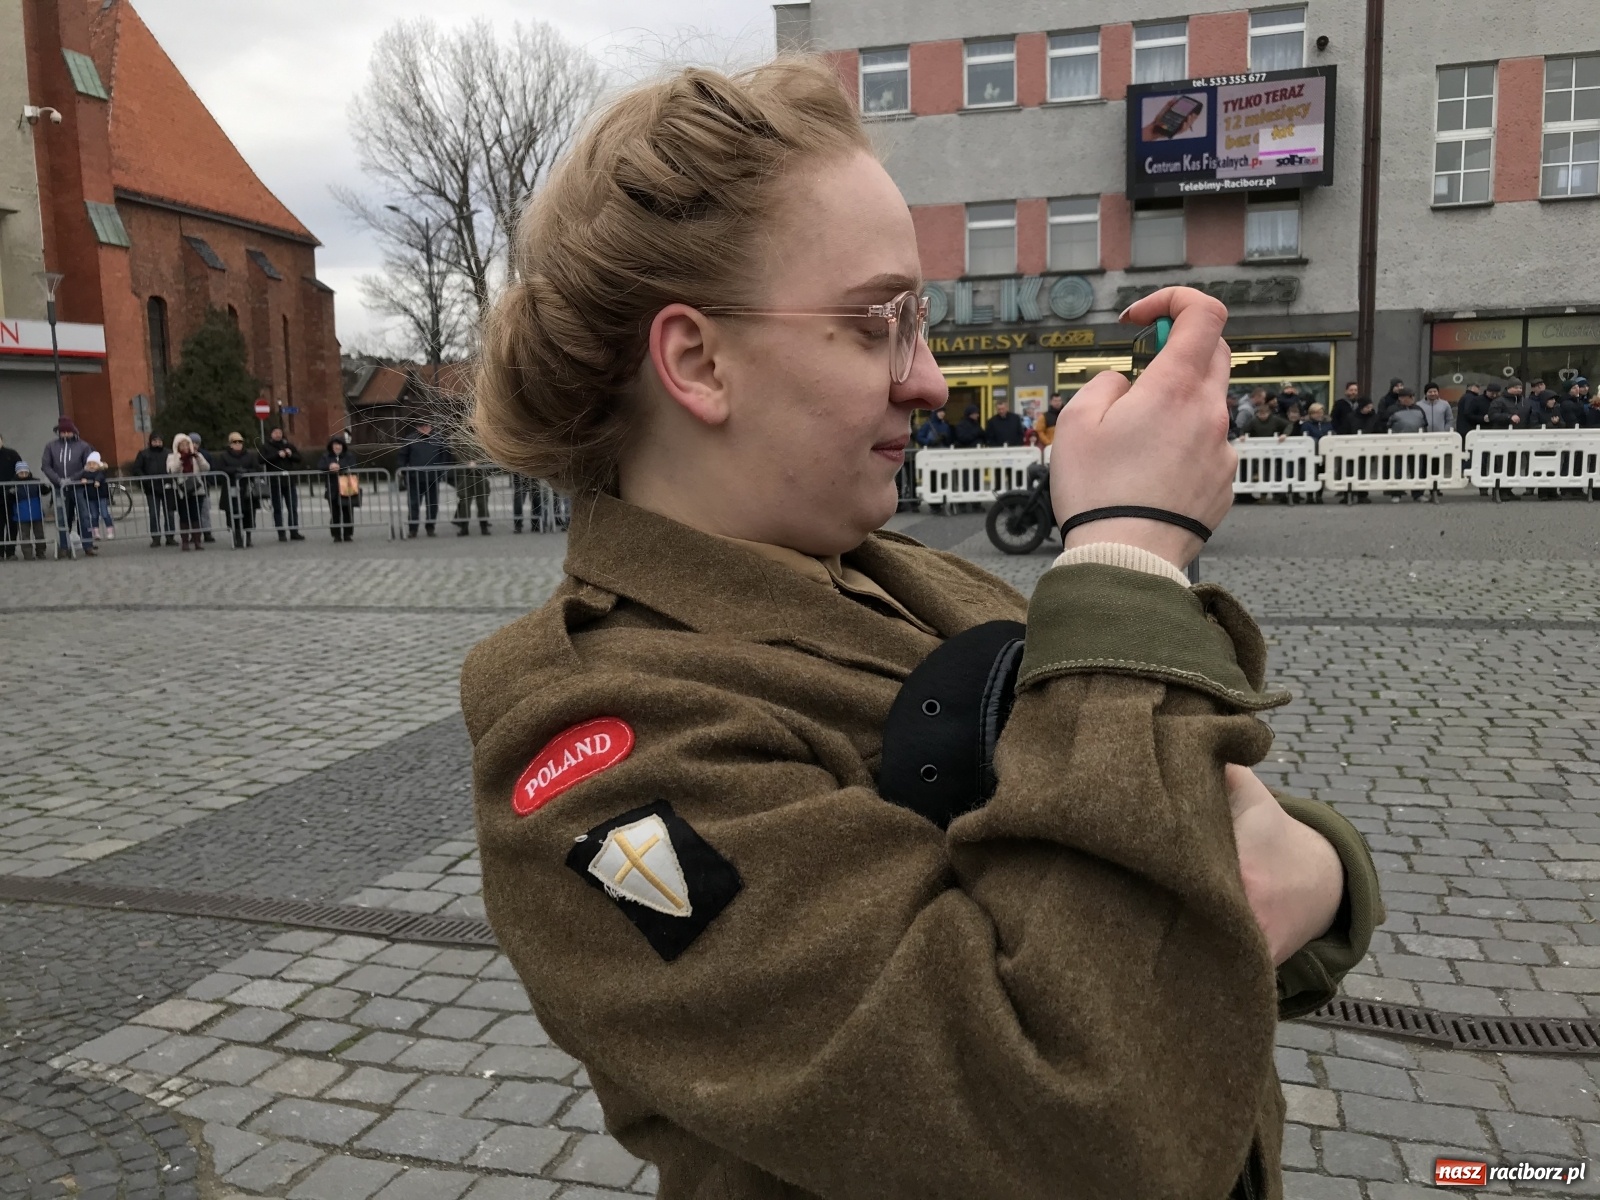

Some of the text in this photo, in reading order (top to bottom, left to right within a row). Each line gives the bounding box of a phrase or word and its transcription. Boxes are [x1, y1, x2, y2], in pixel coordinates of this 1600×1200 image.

[1192, 73, 1267, 87] tel. 533 355 677
[1223, 84, 1305, 113] TYLKO TERAZ
[1224, 115, 1242, 131] 12
[1144, 157, 1181, 174] Centrum
[1183, 154, 1201, 171] Kas
[1179, 176, 1277, 192] Telebimy-Raciborz.pl
[929, 332, 1028, 352] IKATESY
[524, 733, 611, 799] POLAND
